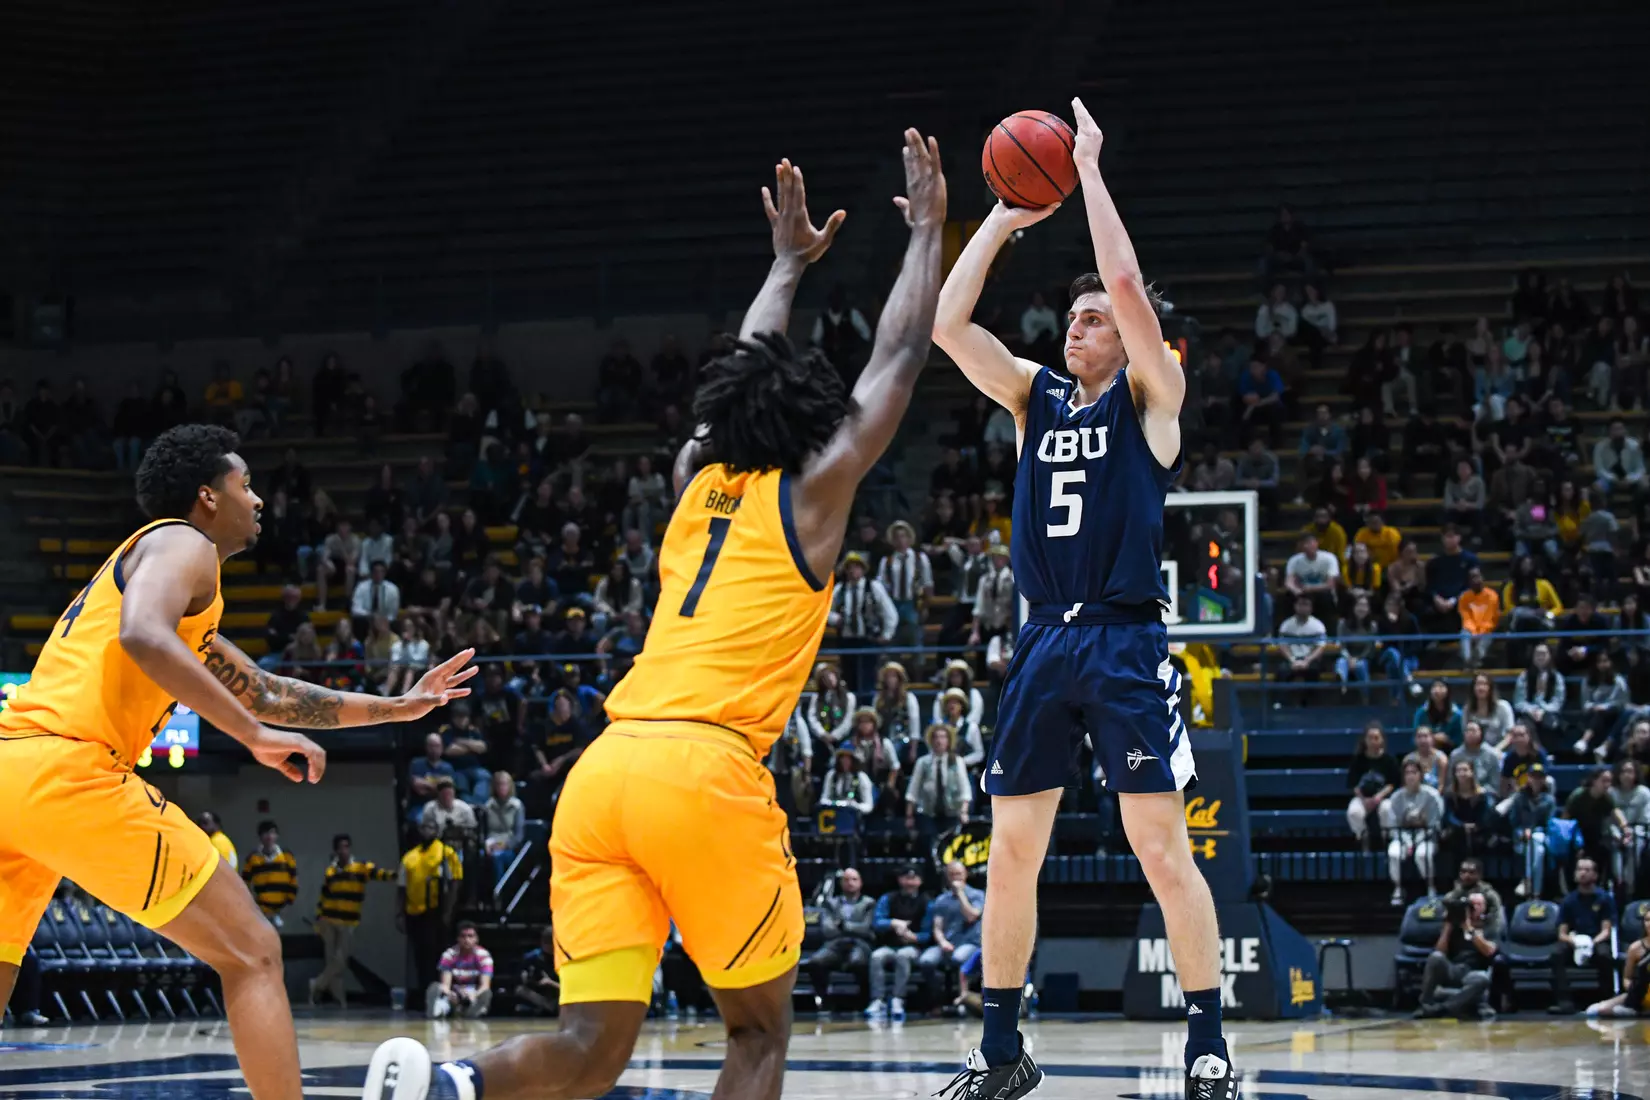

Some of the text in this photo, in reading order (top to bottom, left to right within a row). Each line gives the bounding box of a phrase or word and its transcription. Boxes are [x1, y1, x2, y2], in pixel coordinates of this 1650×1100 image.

[1036, 425, 1108, 463] CBU
[1046, 469, 1087, 538] 5
[678, 516, 733, 618] 1
[818, 810, 837, 833] C
[1185, 796, 1222, 828] Cal
[1161, 973, 1237, 1008] MK
